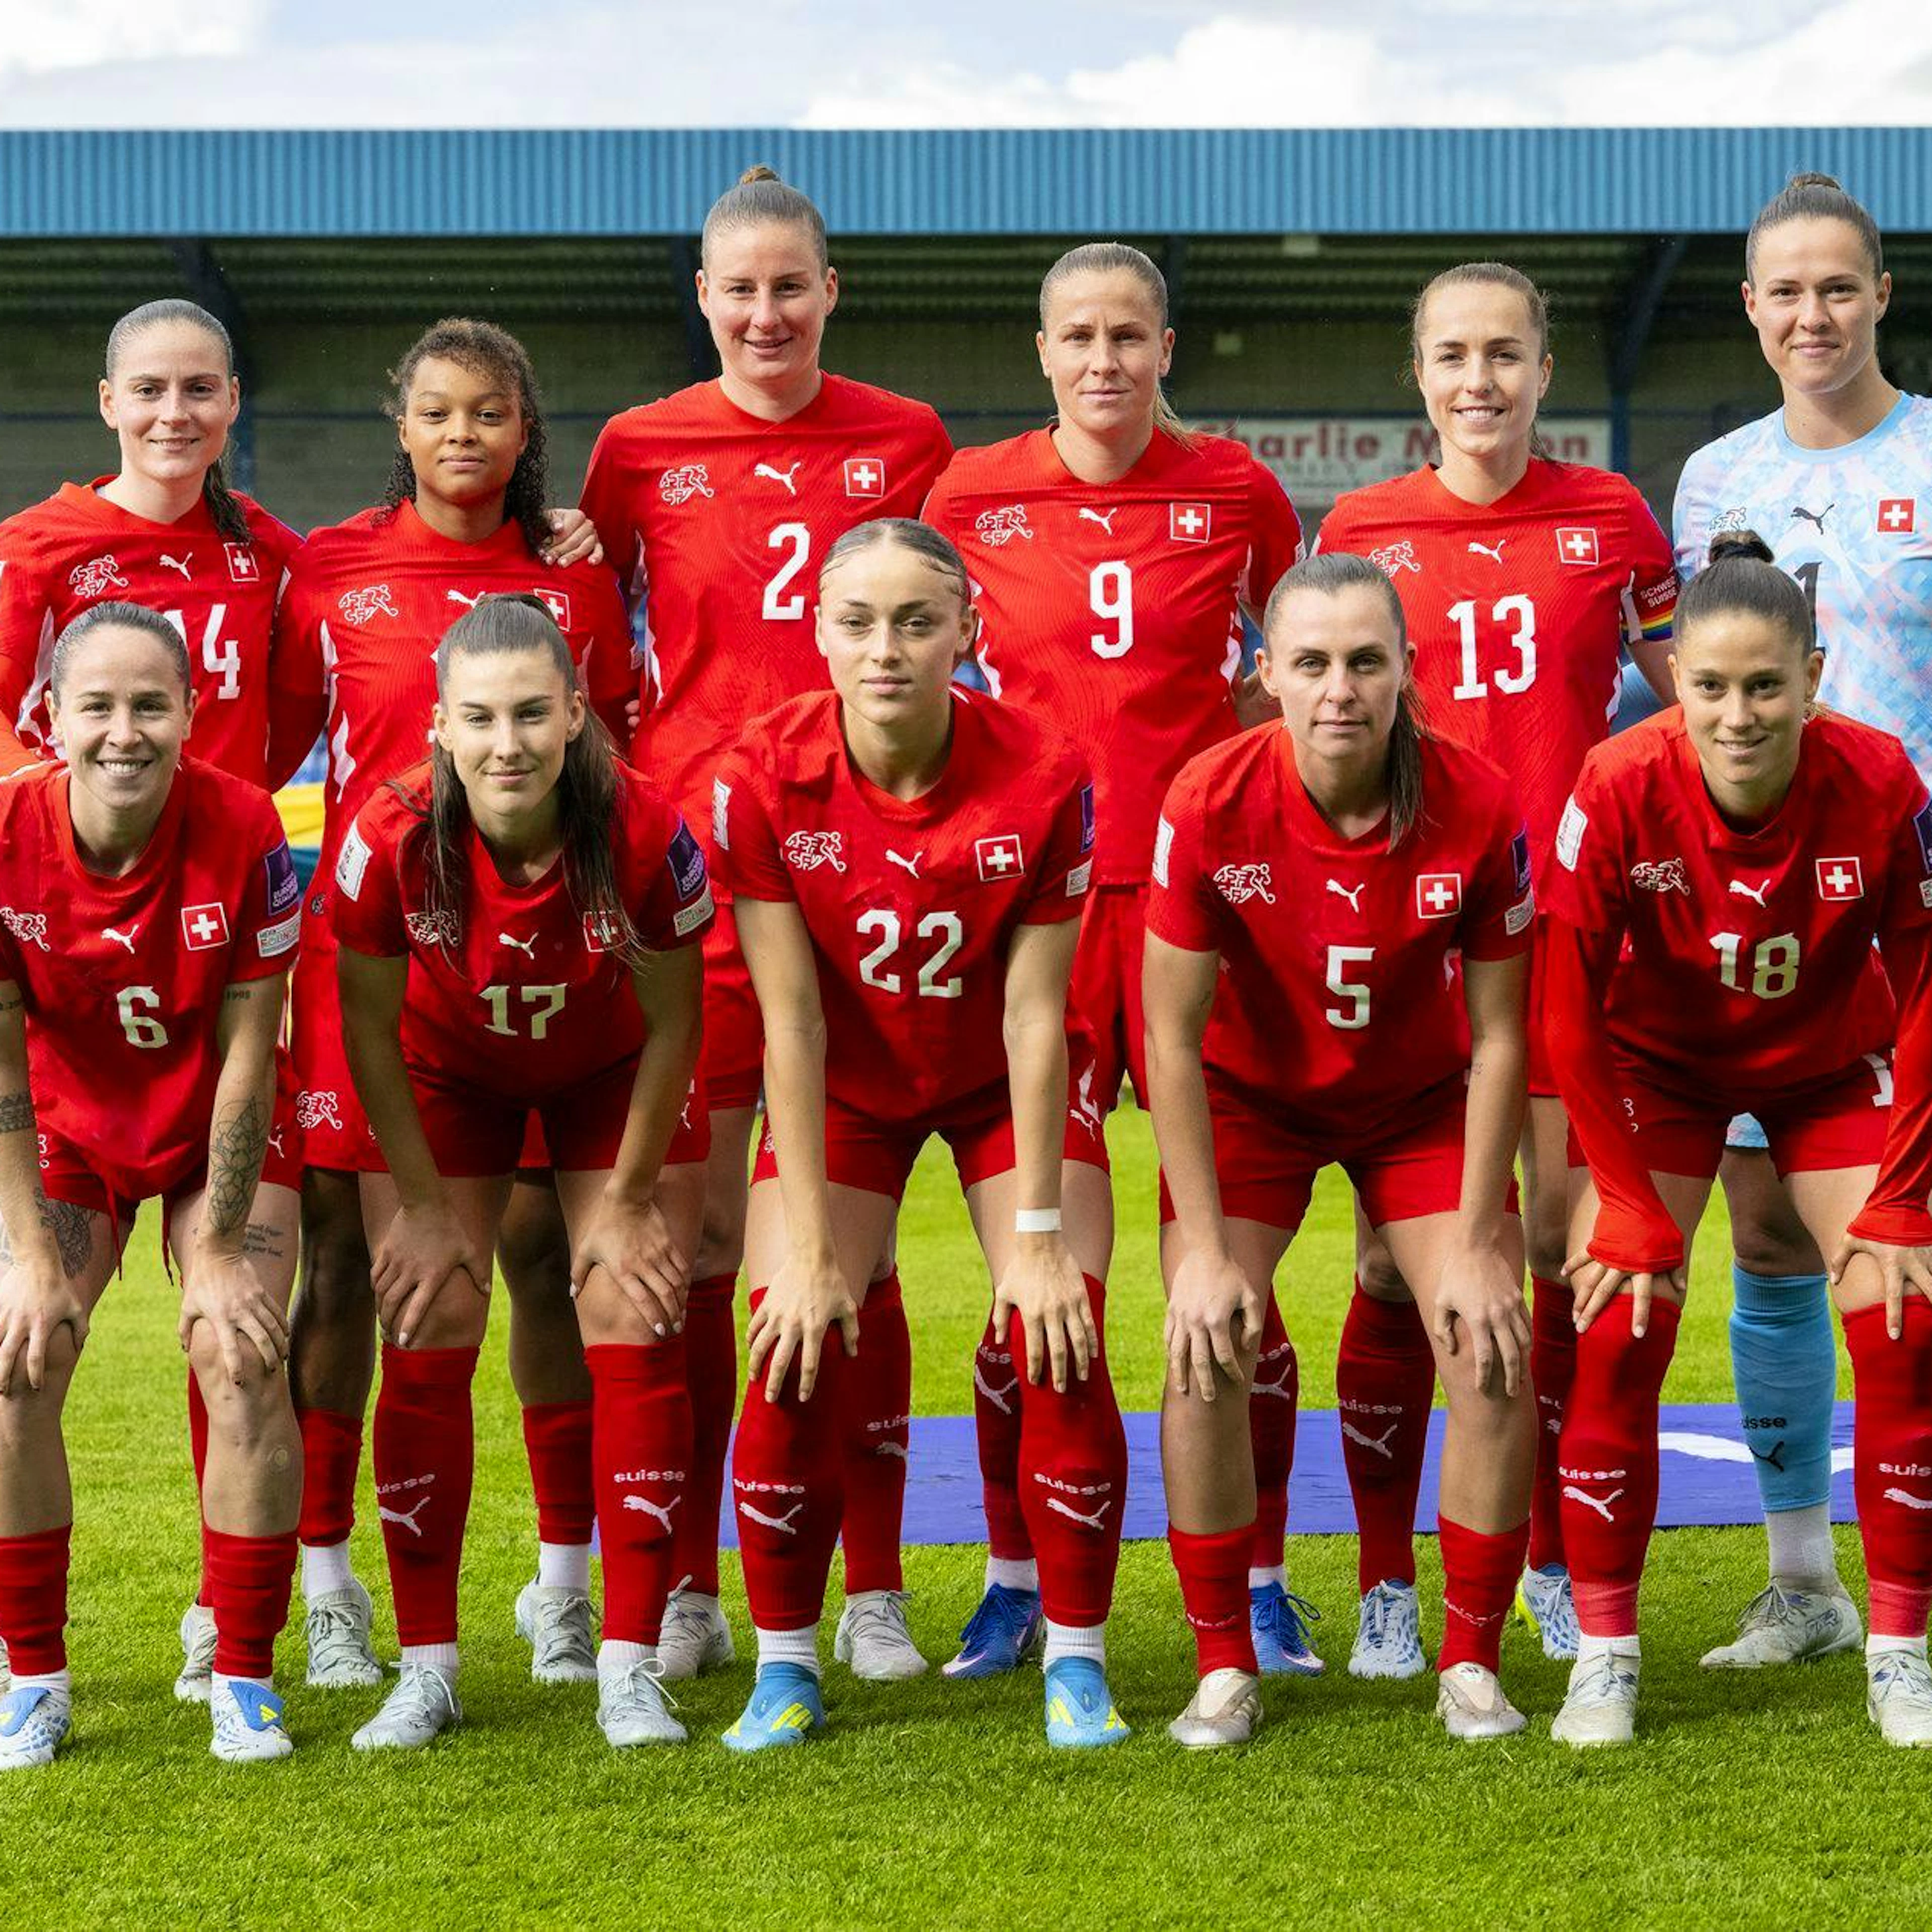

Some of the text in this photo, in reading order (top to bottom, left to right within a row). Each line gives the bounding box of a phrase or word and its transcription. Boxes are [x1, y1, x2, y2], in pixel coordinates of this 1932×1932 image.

[1199, 423, 1380, 459] harlie
[762, 522, 810, 620] 2
[1090, 560, 1133, 659] 9
[1446, 595, 1536, 701] 13
[856, 909, 962, 998] 22
[1709, 932, 1800, 1000] 18
[479, 983, 568, 1039] 17
[1326, 945, 1376, 1029] 5
[117, 986, 168, 1049] 6
[376, 1473, 436, 1495] uisse
[613, 1469, 685, 1483] suisse
[733, 1478, 806, 1494] suisse
[1033, 1473, 1111, 1496] suisse
[1559, 1466, 1627, 1480] suisse
[1879, 1463, 1932, 1477] suis
